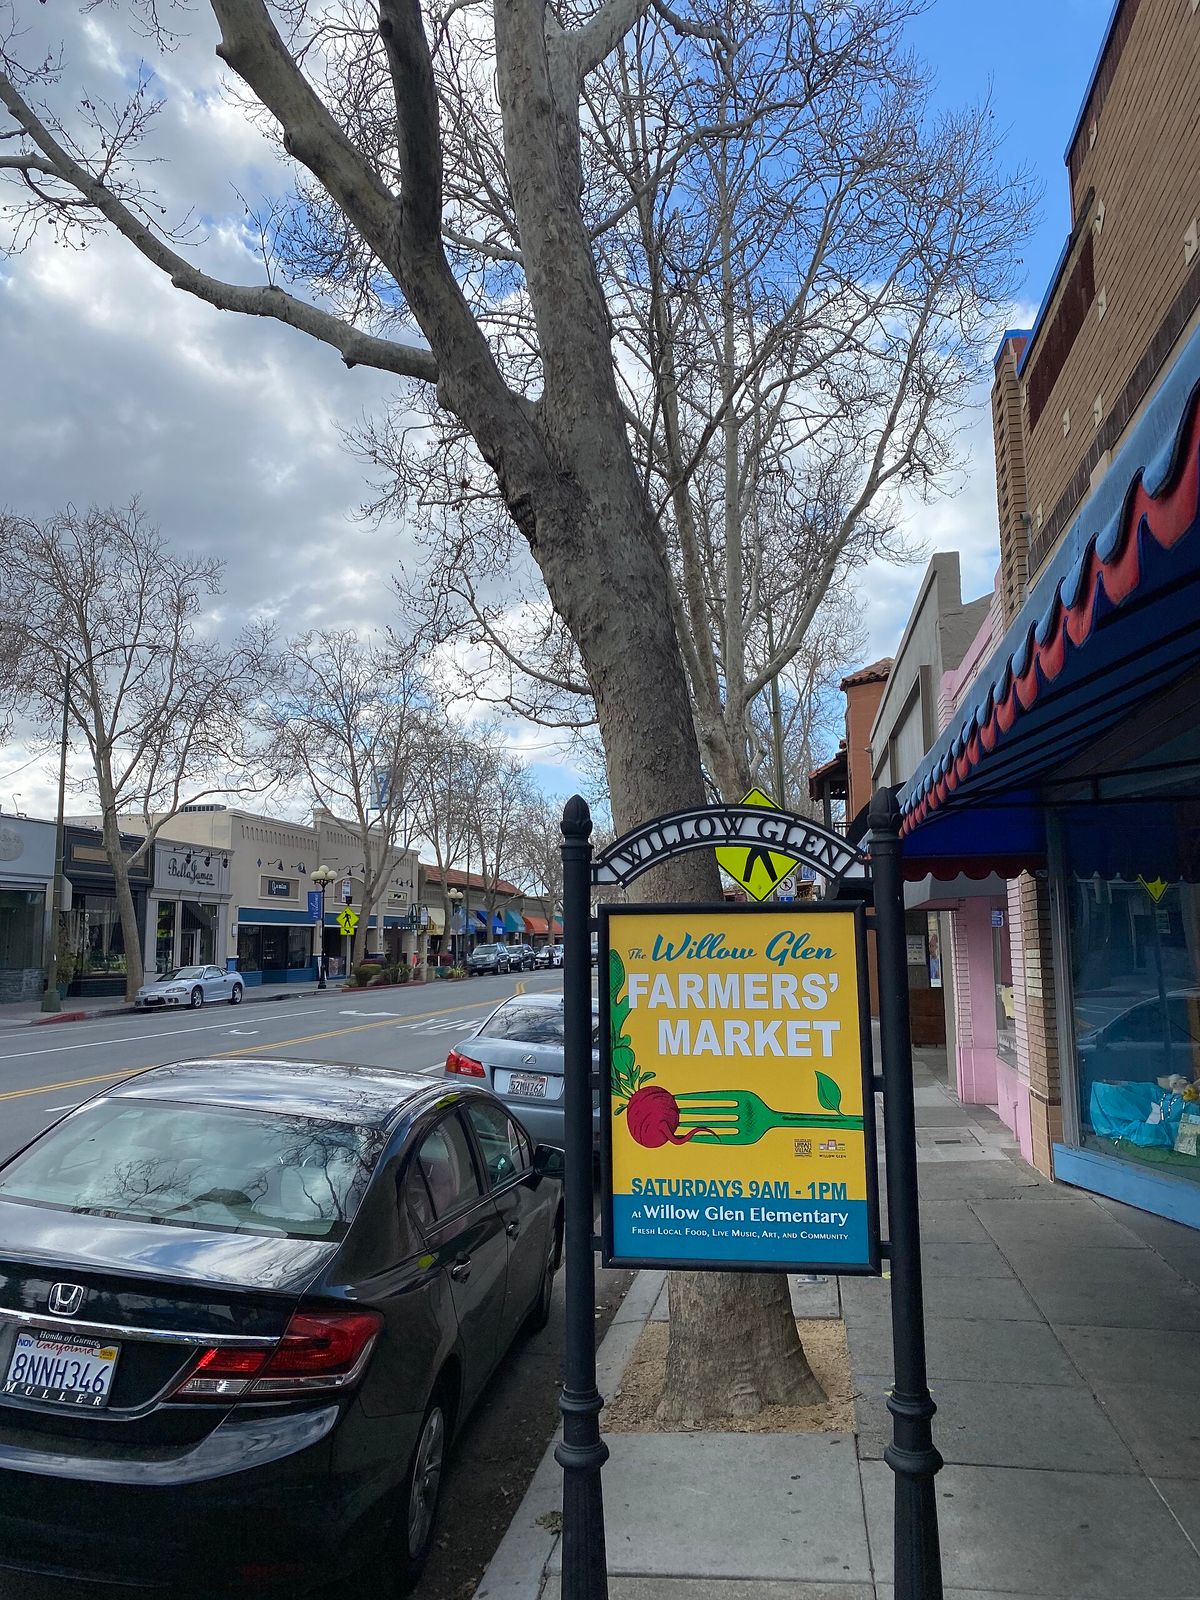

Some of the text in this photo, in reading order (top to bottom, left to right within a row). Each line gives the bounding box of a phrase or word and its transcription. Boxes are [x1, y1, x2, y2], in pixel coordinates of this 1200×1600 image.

[617, 816, 847, 874] WILLOW GLEN
[168, 857, 190, 879] Bella
[628, 930, 837, 966] The Willow Glen
[627, 973, 839, 1010] FARMERS'
[657, 1019, 841, 1057] MARKET
[631, 1177, 744, 1198] SATURDAYS
[749, 1180, 790, 1199] 9AM
[807, 1181, 848, 1201] 1PM
[643, 1203, 700, 1220] Willow
[704, 1205, 745, 1221] Glen
[750, 1206, 849, 1227] Elementary
[17, 1338, 34, 1348] NOV
[39, 1330, 63, 1342] Honda
[63, 1334, 74, 1344] of
[12, 1353, 110, 1394] 8NNH346
[2, 1380, 102, 1406] MULLER
